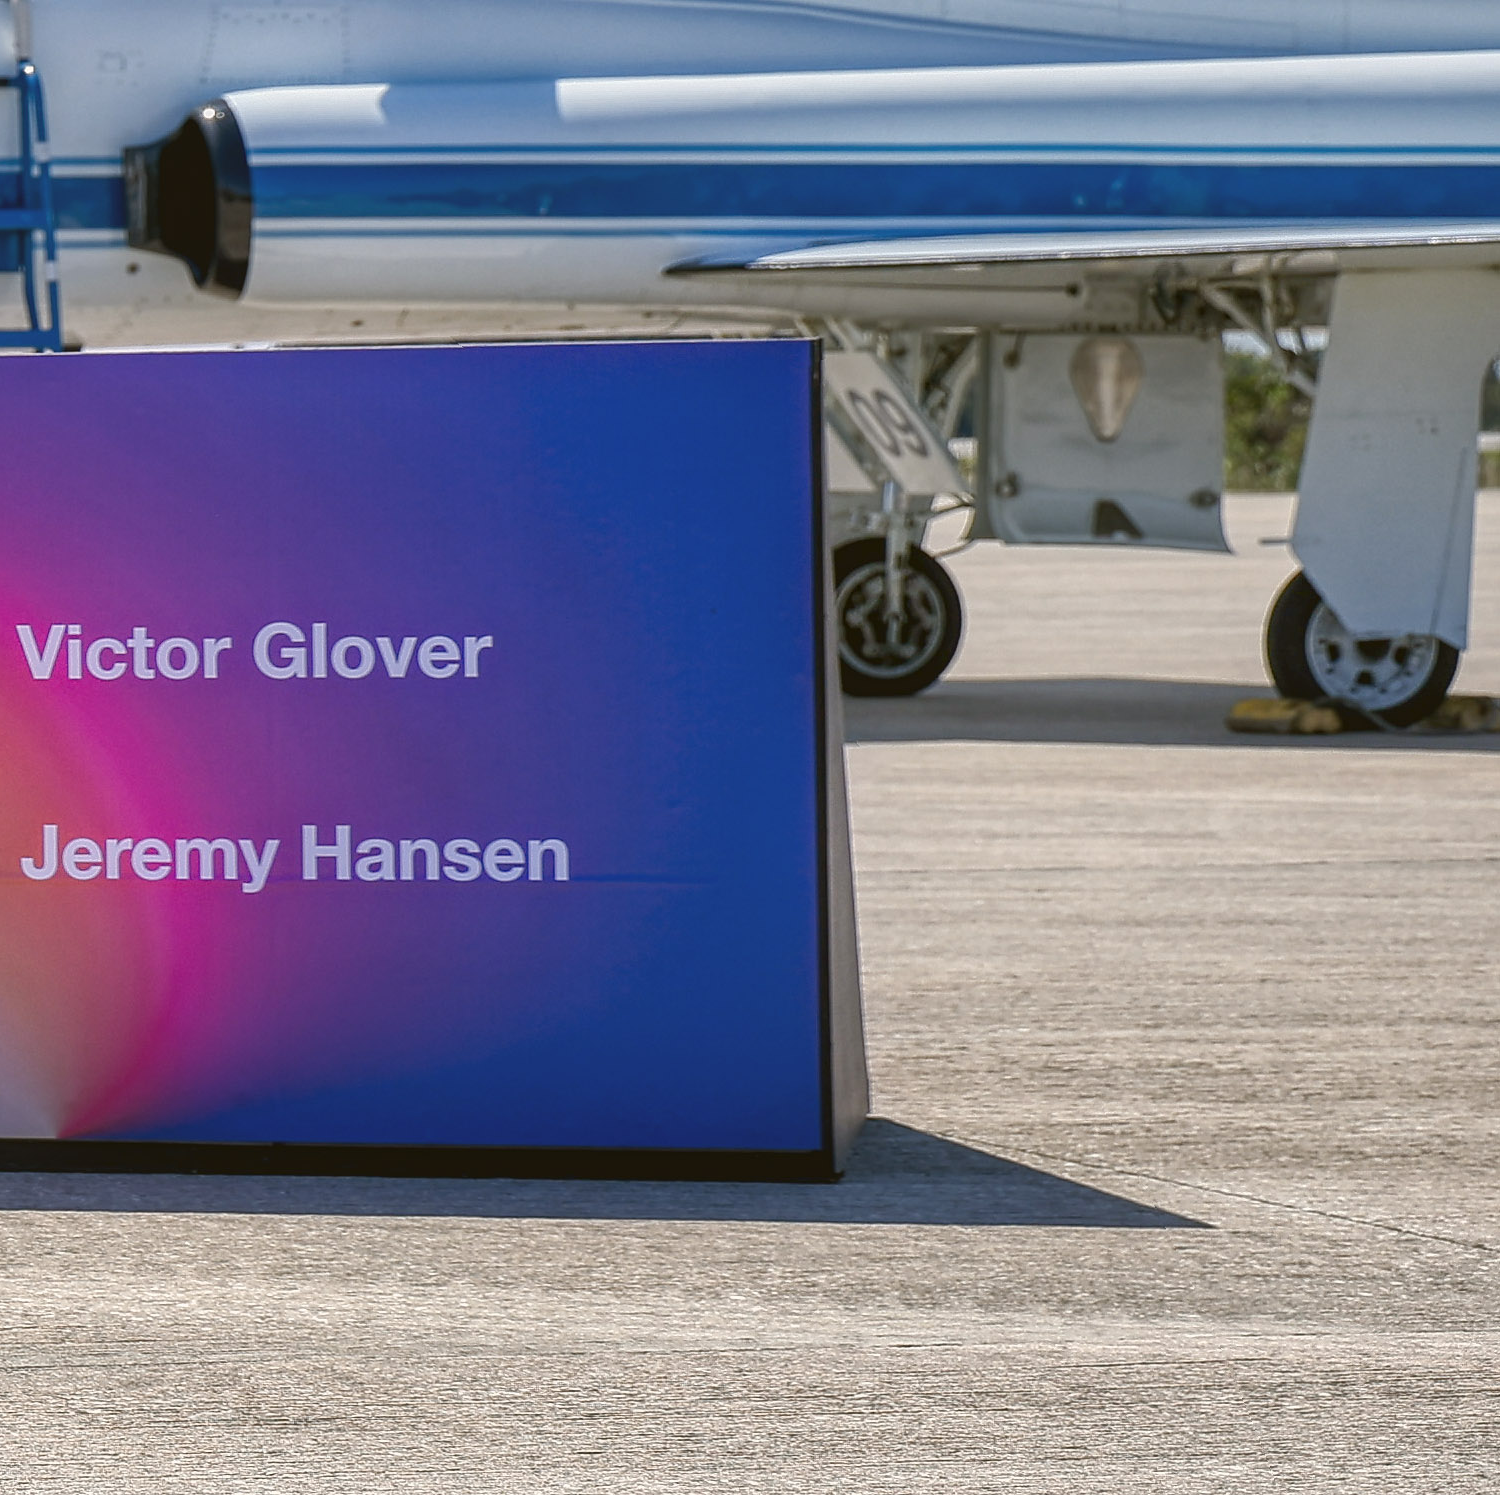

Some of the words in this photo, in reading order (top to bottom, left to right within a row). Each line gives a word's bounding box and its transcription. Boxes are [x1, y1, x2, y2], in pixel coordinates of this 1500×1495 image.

[846, 389, 928, 459] 09
[16, 624, 232, 680] Victor
[253, 622, 493, 680] Glover
[21, 824, 280, 894] Jeremy
[302, 825, 569, 882] Hansen
